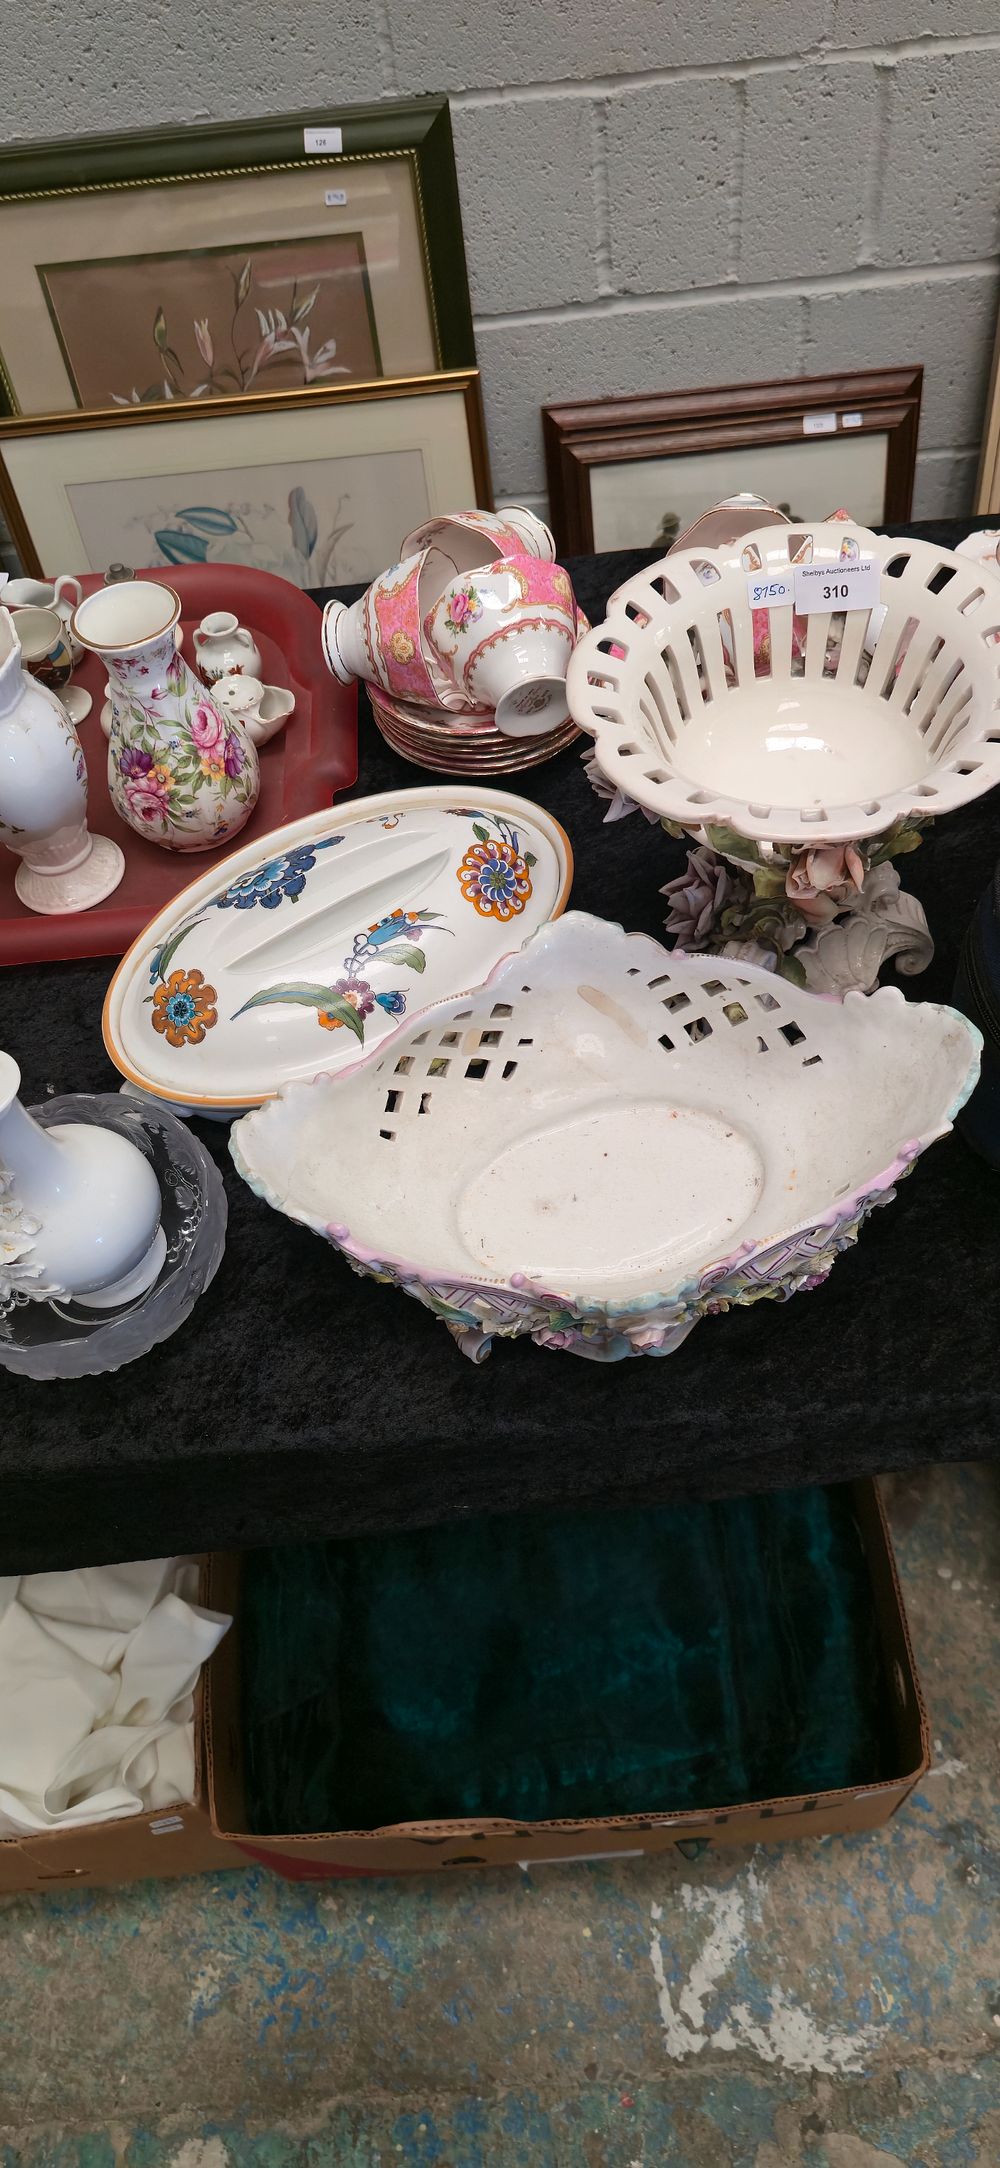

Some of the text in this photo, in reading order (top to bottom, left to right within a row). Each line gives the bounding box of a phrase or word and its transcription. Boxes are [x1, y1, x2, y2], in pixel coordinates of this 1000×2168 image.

[802, 564, 871, 578] Shelbys Auctioneers Ltd
[823, 584, 849, 599] 310
